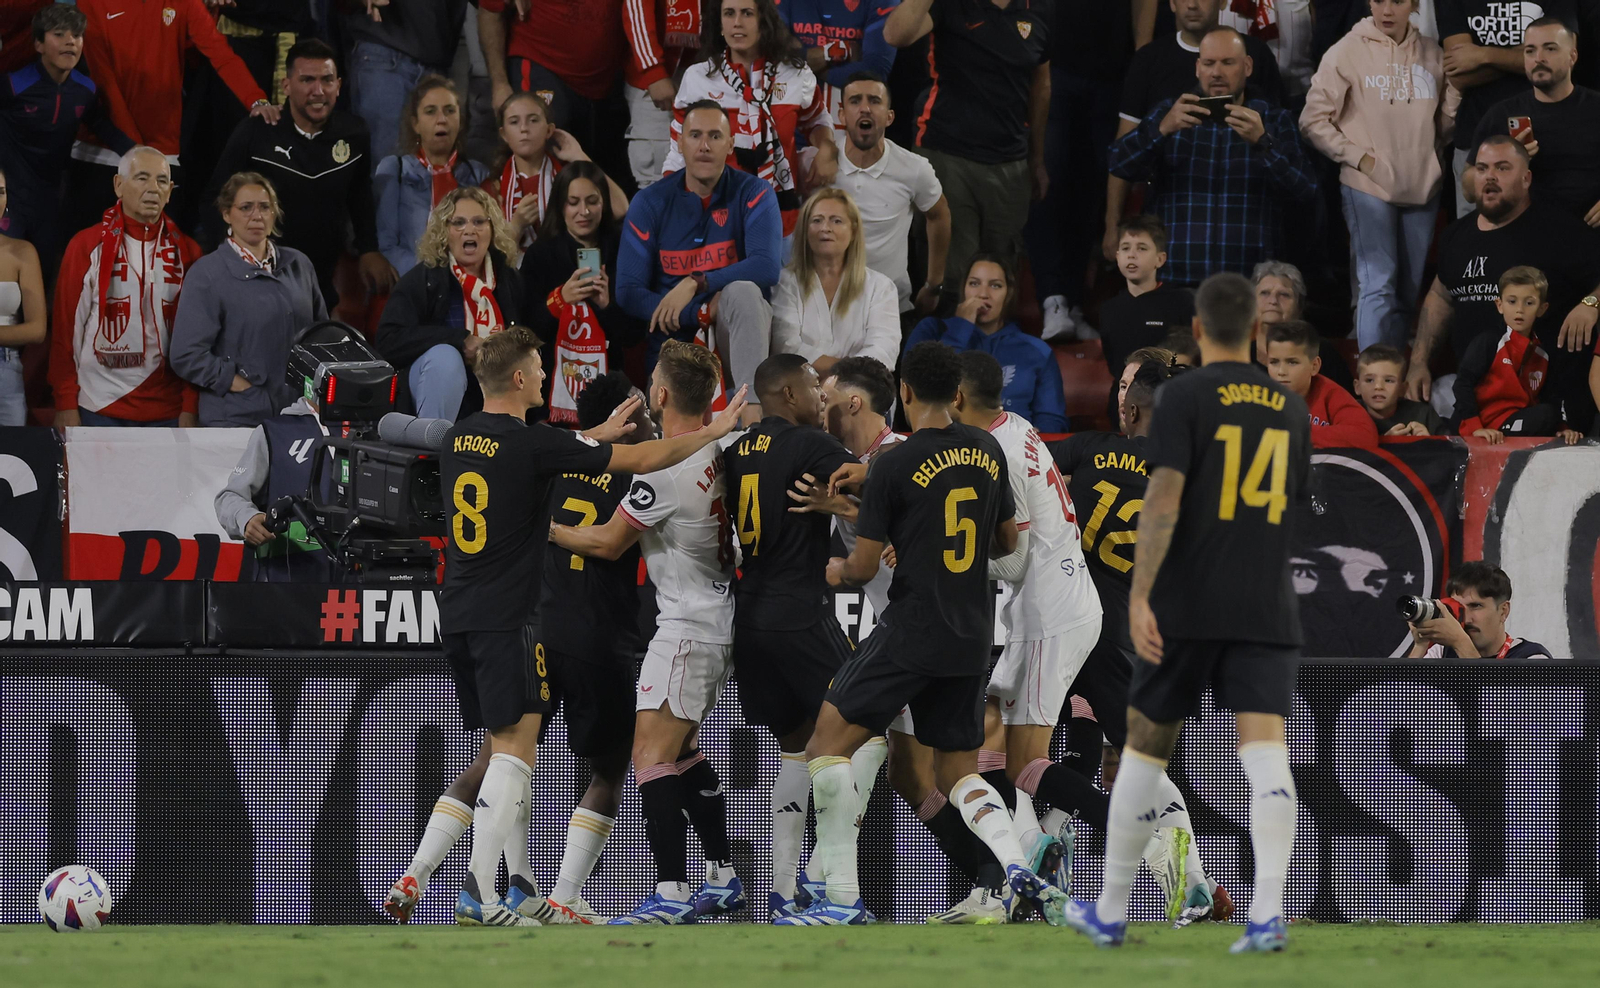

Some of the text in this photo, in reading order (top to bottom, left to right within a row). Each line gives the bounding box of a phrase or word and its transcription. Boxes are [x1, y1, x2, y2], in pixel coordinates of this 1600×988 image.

[1487, 2, 1520, 17] THE
[662, 245, 735, 270] SEVILLA FC
[1217, 383, 1286, 411] JOSELU
[453, 435, 500, 458] KROOS
[911, 447, 1000, 489] BELLINGHAM
[1214, 424, 1291, 525] 14
[452, 471, 489, 555] 8
[737, 473, 761, 556] 4
[943, 486, 979, 573] 5
[535, 642, 547, 678] 8
